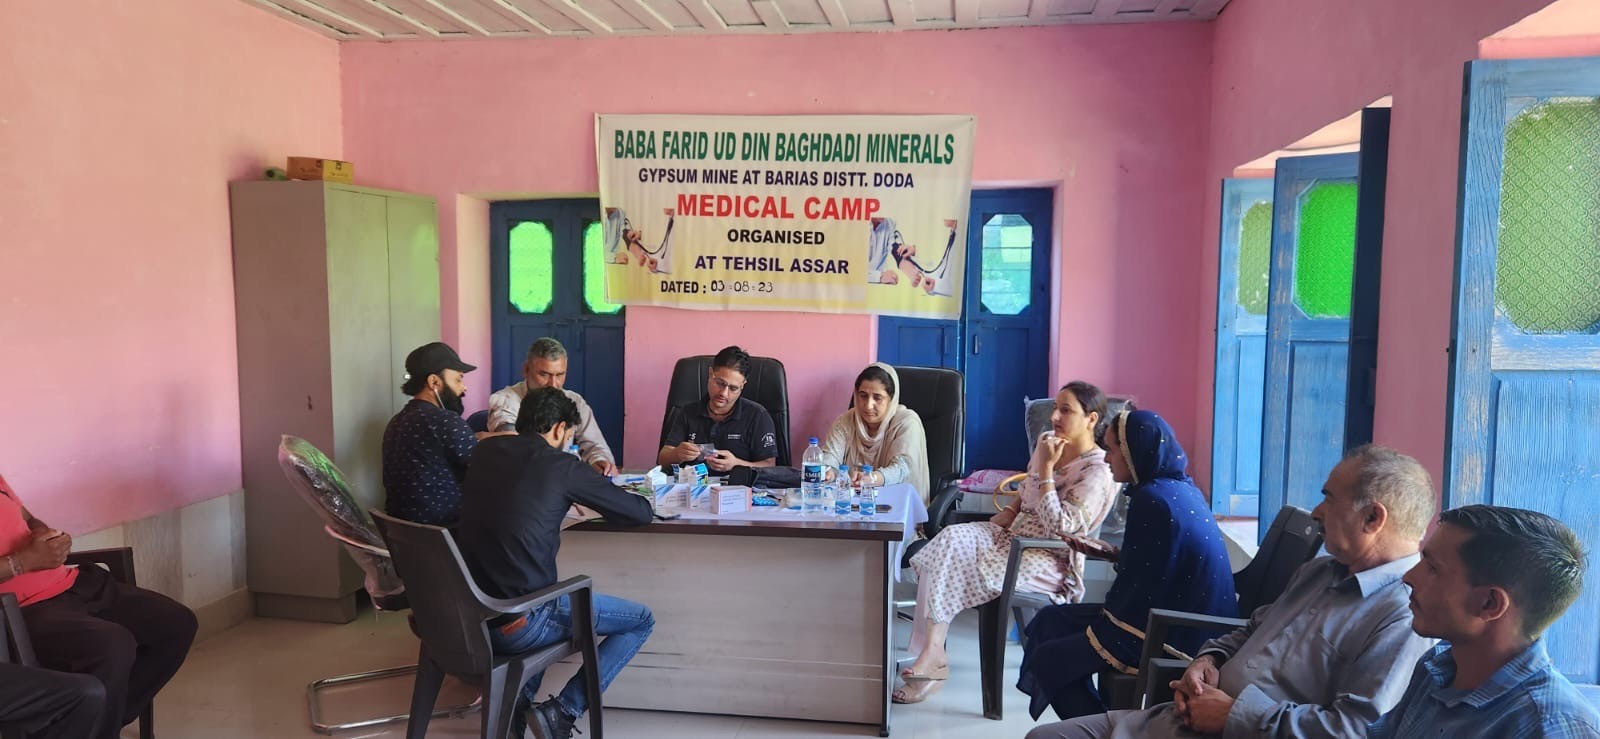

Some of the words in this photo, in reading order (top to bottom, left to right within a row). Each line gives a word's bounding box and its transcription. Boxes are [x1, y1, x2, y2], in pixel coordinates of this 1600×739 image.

[614, 129, 657, 159] BABA
[662, 130, 708, 160] FARID
[713, 131, 737, 161] UD
[741, 132, 770, 161] DIN
[775, 132, 861, 163] BAGHDADI
[866, 133, 955, 165] MINERALS
[638, 167, 698, 184] GYPSUM
[702, 168, 738, 185] MINE
[742, 170, 761, 185] AT
[765, 170, 818, 187] BARIAS
[823, 171, 868, 188] DISTT.
[873, 172, 914, 189] DODA
[677, 193, 795, 220] MEDICAL
[803, 196, 881, 221] CAMP
[727, 228, 825, 246] ORGANISED
[695, 255, 718, 271] AT
[723, 256, 785, 273] TEHSIL
[789, 257, 850, 275] ASSAR
[660, 280, 699, 294] DATED
